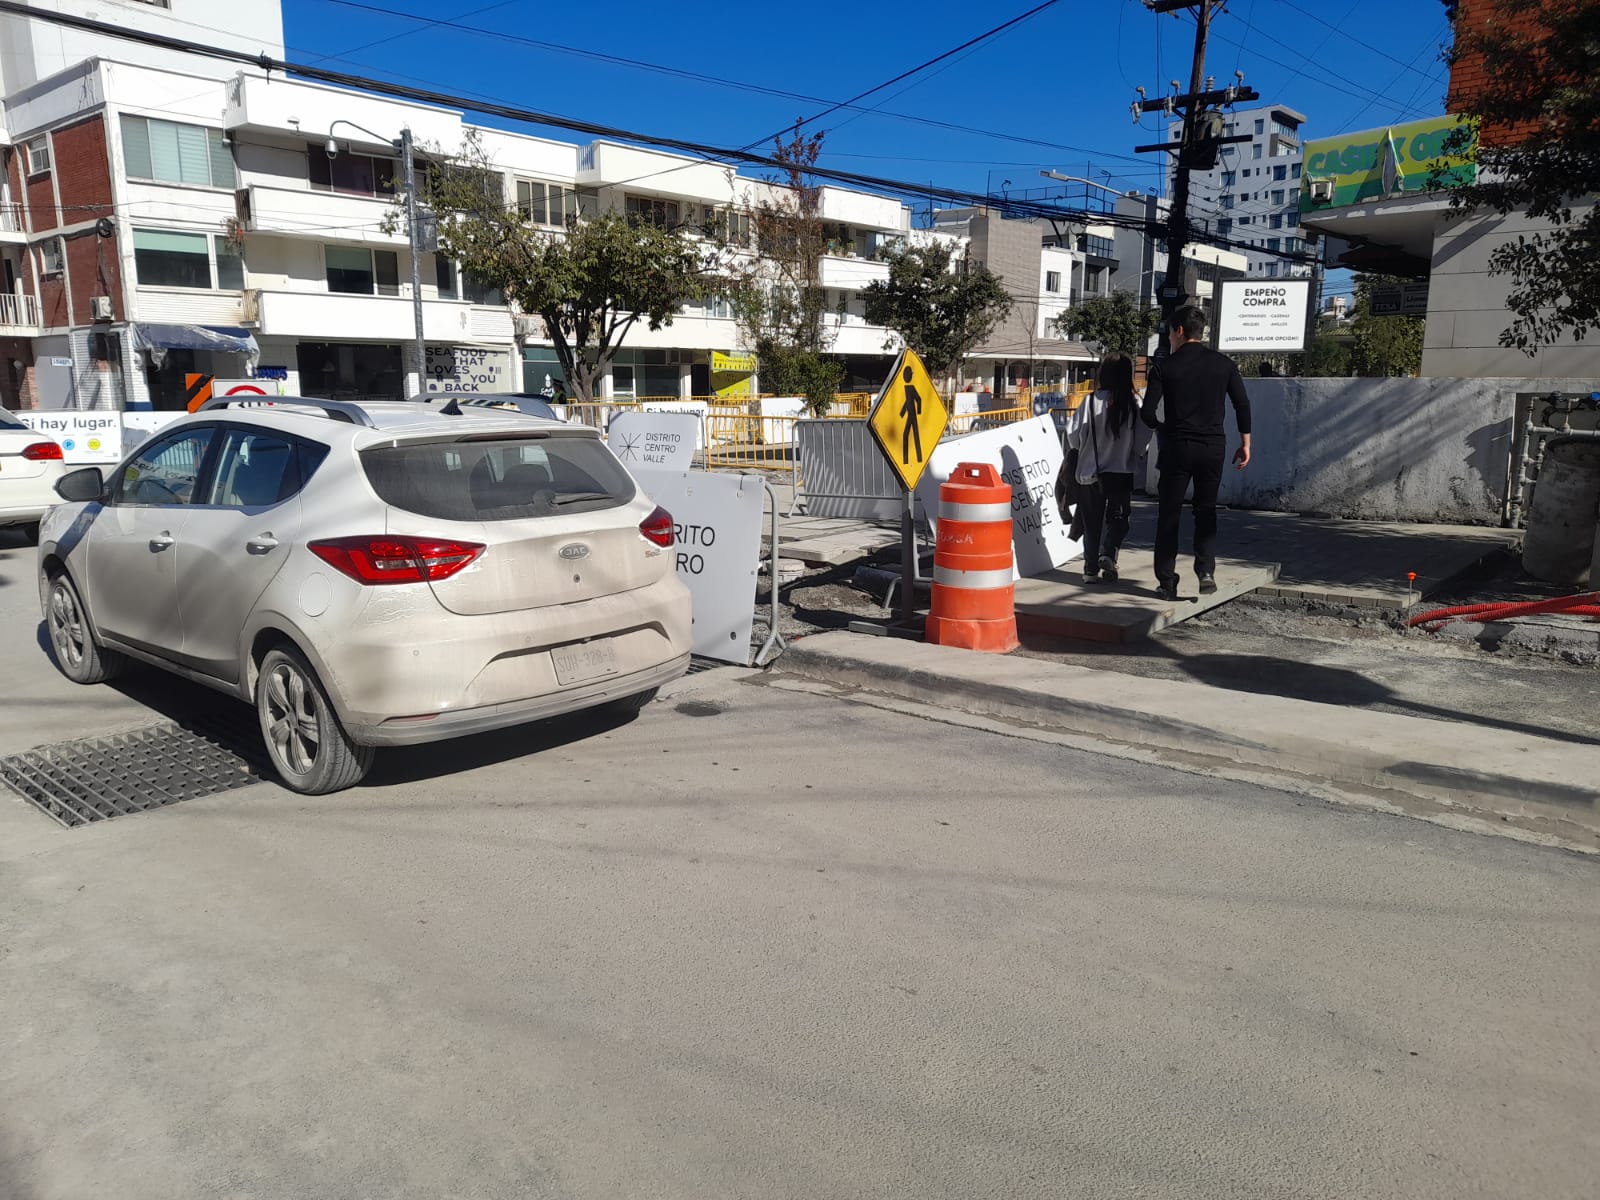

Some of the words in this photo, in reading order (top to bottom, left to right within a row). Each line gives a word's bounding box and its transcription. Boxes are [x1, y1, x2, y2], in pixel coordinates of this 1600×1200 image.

[1245, 286, 1286, 297] EMPEÑO
[1243, 298, 1286, 306] COMPRA
[425, 347, 487, 356] SEAFOOD
[451, 357, 485, 366] THAT
[426, 365, 470, 374] LOVES
[470, 374, 496, 383] YOU
[444, 383, 480, 392] BACK
[41, 419, 68, 431] hay
[73, 417, 117, 430] lugar.
[645, 432, 681, 443] DISTRITO
[644, 443, 676, 453] CENTRO
[643, 454, 665, 463] VALLE
[1000, 459, 1050, 486] DISTRITO
[1011, 482, 1053, 511] CENTRO
[1017, 508, 1052, 534] VALLE
